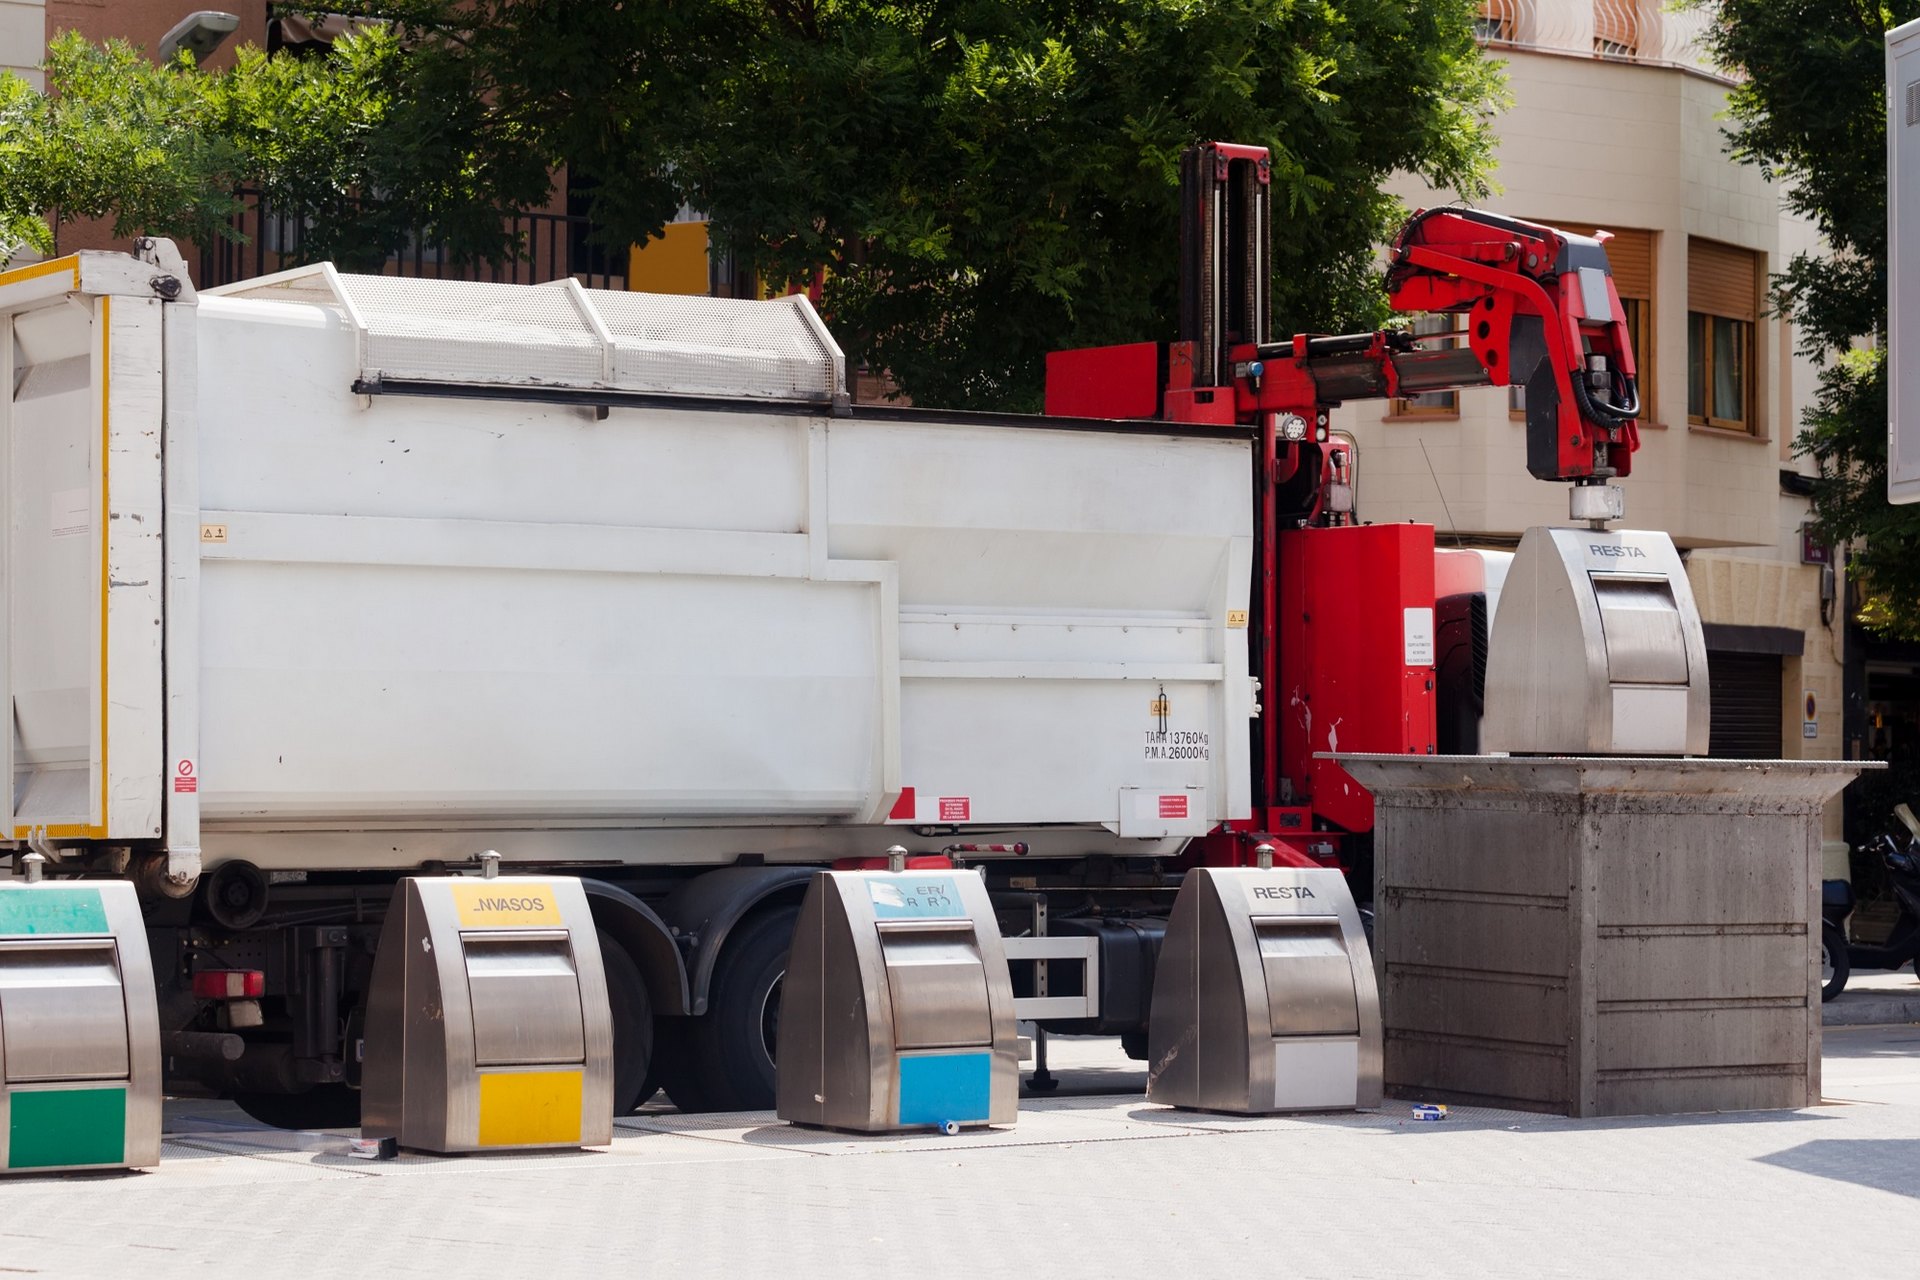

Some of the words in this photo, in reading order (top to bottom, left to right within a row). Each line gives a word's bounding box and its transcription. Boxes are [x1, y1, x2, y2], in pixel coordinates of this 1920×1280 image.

[1589, 545, 1647, 558] RESTA
[1145, 731, 1167, 744] TARA
[1253, 886, 1315, 899] RESTA
[473, 898, 545, 911] NVASOS
